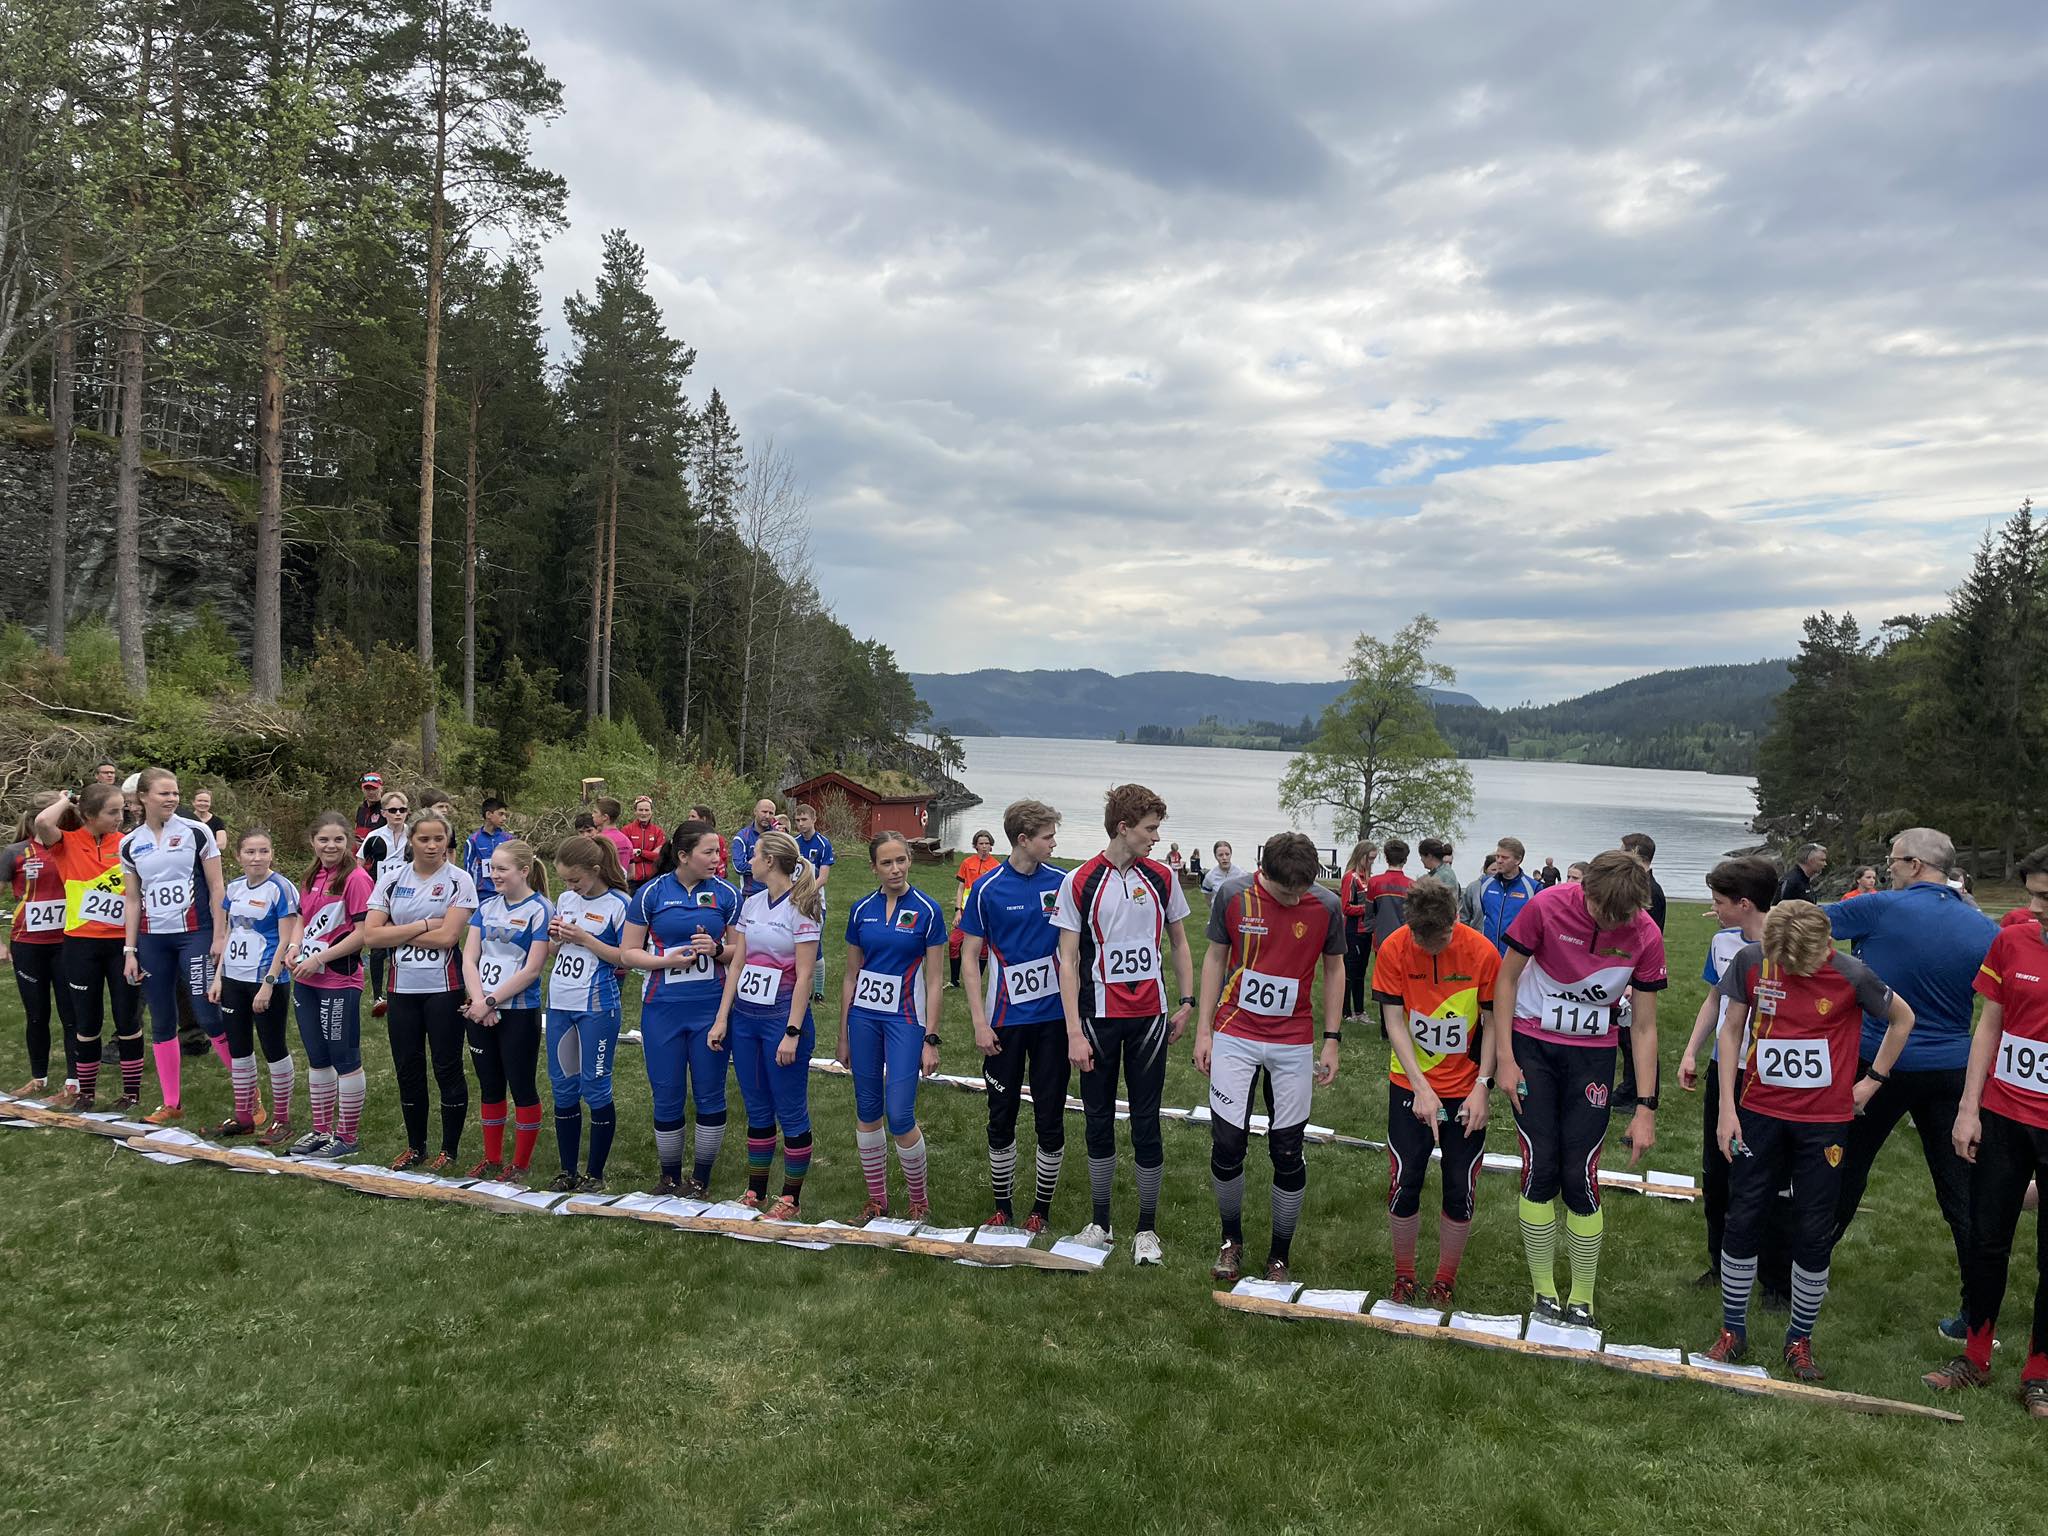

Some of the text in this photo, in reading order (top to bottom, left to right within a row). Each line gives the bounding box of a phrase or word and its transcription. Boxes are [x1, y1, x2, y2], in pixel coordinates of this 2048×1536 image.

[85, 896, 124, 918] 248
[150, 886, 184, 908] 188
[31, 905, 66, 926] 247
[230, 940, 248, 960] 94
[1559, 934, 1584, 946] TRIMTEX
[554, 954, 584, 979] 269
[1110, 947, 1151, 975] 259
[482, 962, 502, 986] 93
[740, 971, 772, 997] 251
[1011, 965, 1049, 996] 267
[2015, 972, 2040, 982] TRIMTEX
[858, 977, 894, 1004] 253
[1244, 979, 1288, 1010] 261
[1552, 1005, 1600, 1034] 114
[598, 1038, 608, 1052] OK
[1415, 1020, 1460, 1048] 215
[1764, 1048, 1822, 1079] 265
[2004, 1044, 2048, 1084] 193
